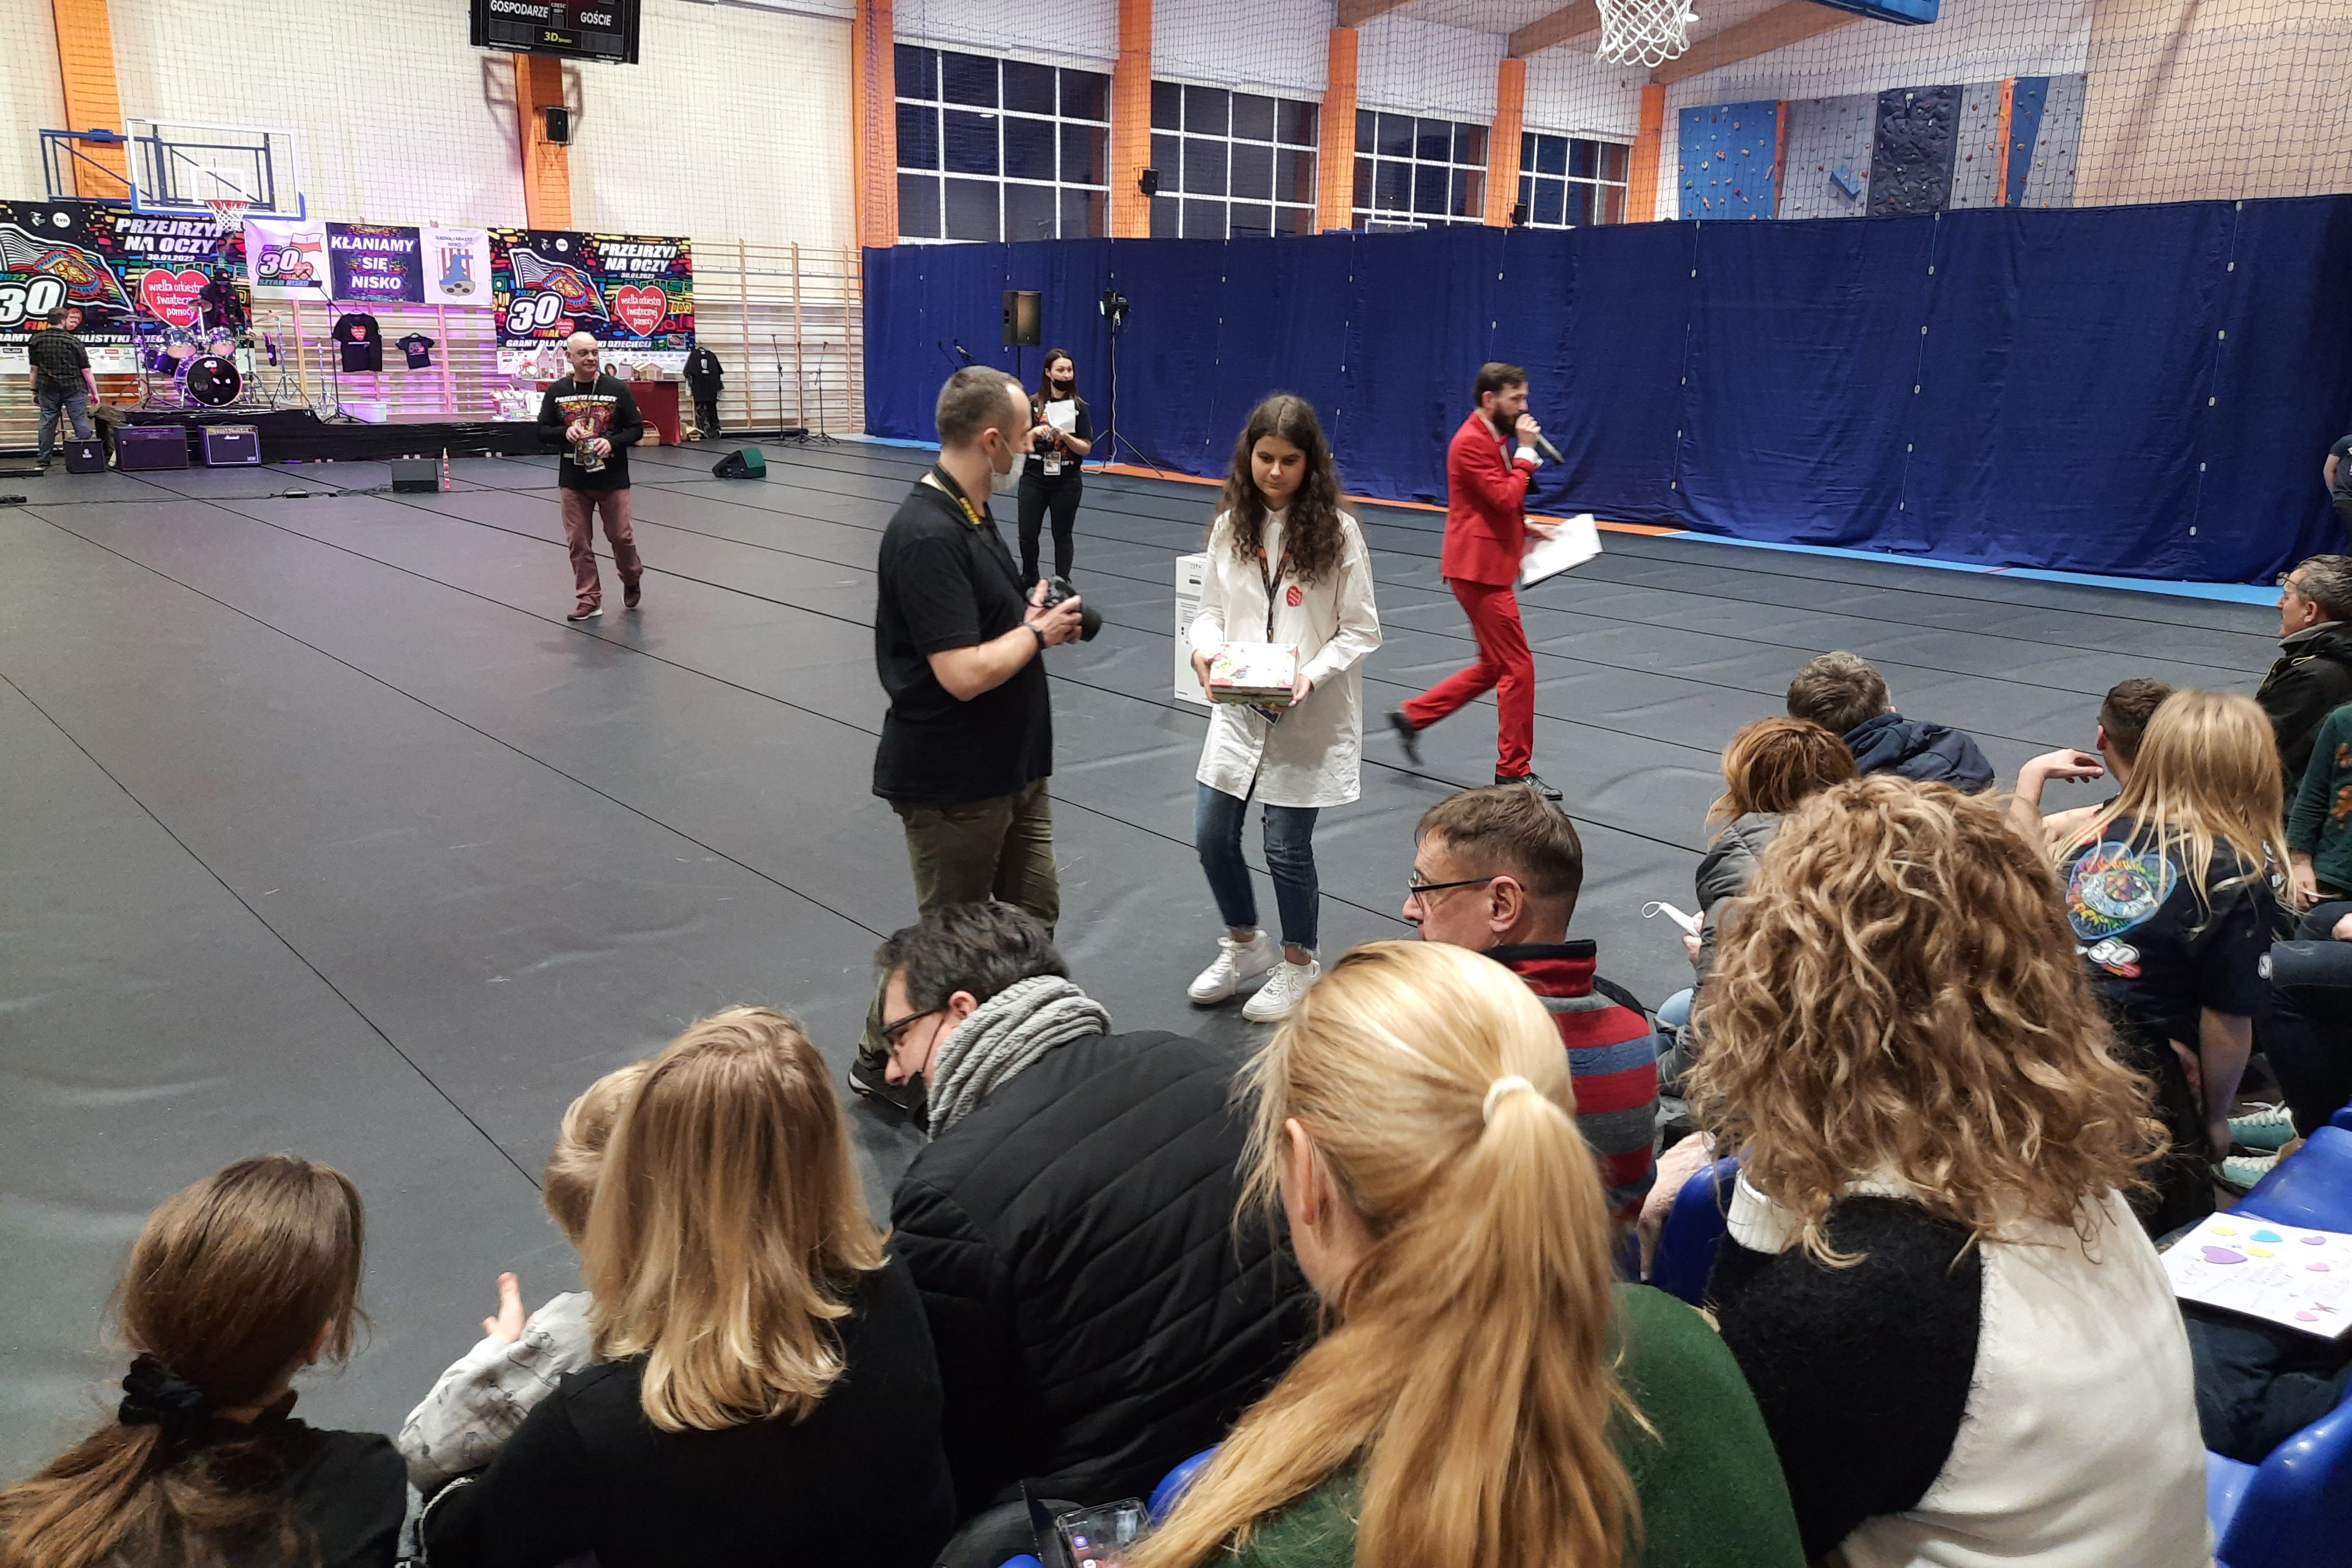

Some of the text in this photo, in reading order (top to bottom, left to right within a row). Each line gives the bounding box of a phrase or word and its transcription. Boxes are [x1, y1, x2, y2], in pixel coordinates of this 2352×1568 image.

[490, 0, 549, 18] GOSPODARZE
[580, 10, 612, 26] GOŚCIE
[115, 218, 224, 237] PRZEJRZYJ
[124, 236, 216, 253] NA OCZY
[331, 236, 415, 252] KŁANIAMY
[599, 243, 677, 258] PRZEJRZYJ
[259, 249, 300, 275] 30
[362, 257, 388, 273] SIĘ
[604, 258, 670, 272] NA OCZY
[148, 279, 203, 293] wielka orkiestr
[352, 276, 401, 289] NISKO
[510, 295, 560, 332] 30
[2089, 940, 2139, 966] 30
